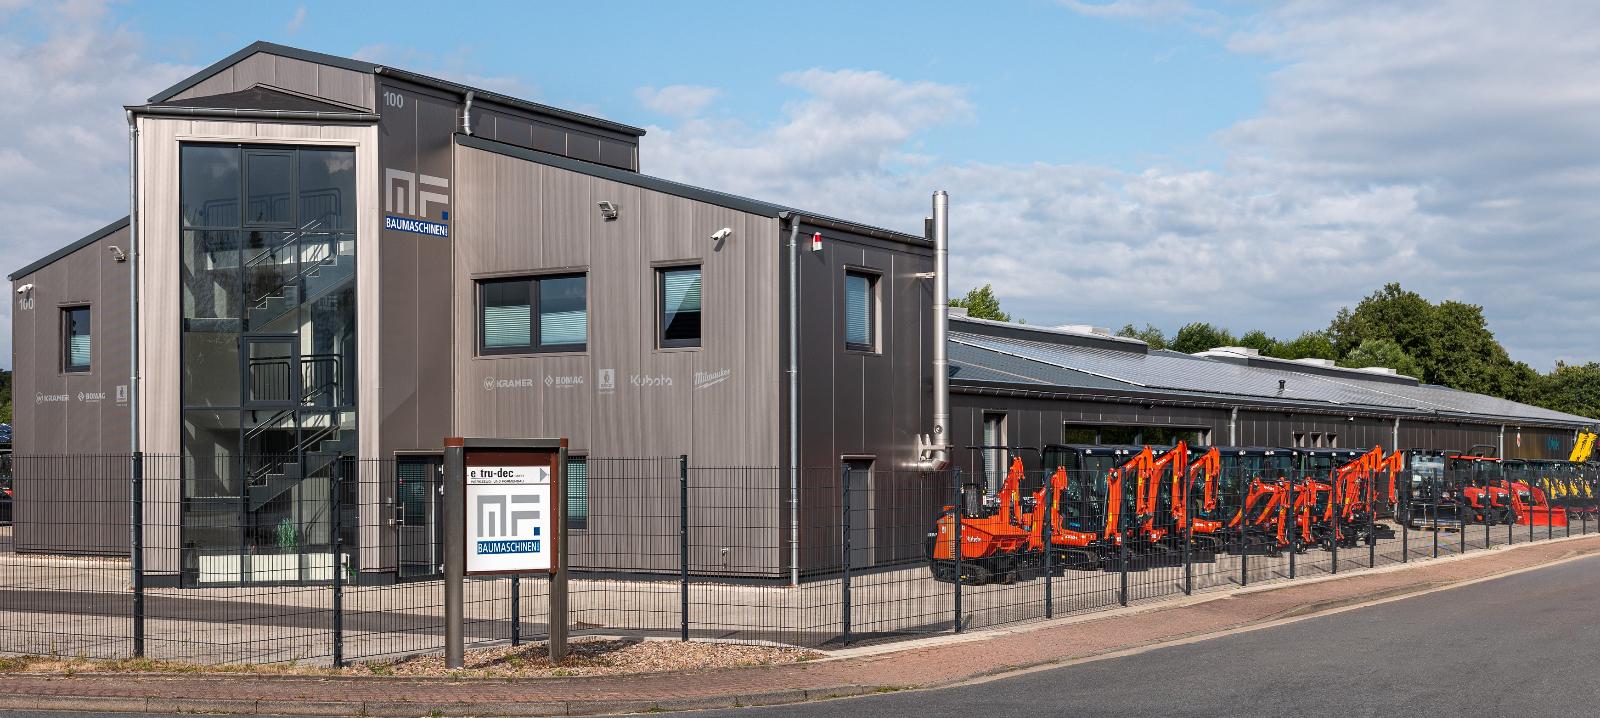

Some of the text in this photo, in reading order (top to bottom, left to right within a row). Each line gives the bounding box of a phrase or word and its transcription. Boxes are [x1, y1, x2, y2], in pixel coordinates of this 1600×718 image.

[384, 91, 404, 109] 100
[386, 218, 445, 236] BAUMASCHINEN
[18, 298, 34, 311] 100
[496, 378, 533, 388] KRAMER
[555, 376, 584, 385] BOMAG
[630, 374, 673, 387] Kubota
[44, 394, 70, 402] KRAMER
[85, 392, 106, 400] BOMAG
[470, 468, 514, 478] etru-dec
[478, 541, 537, 553] BAUMASCHINEN
